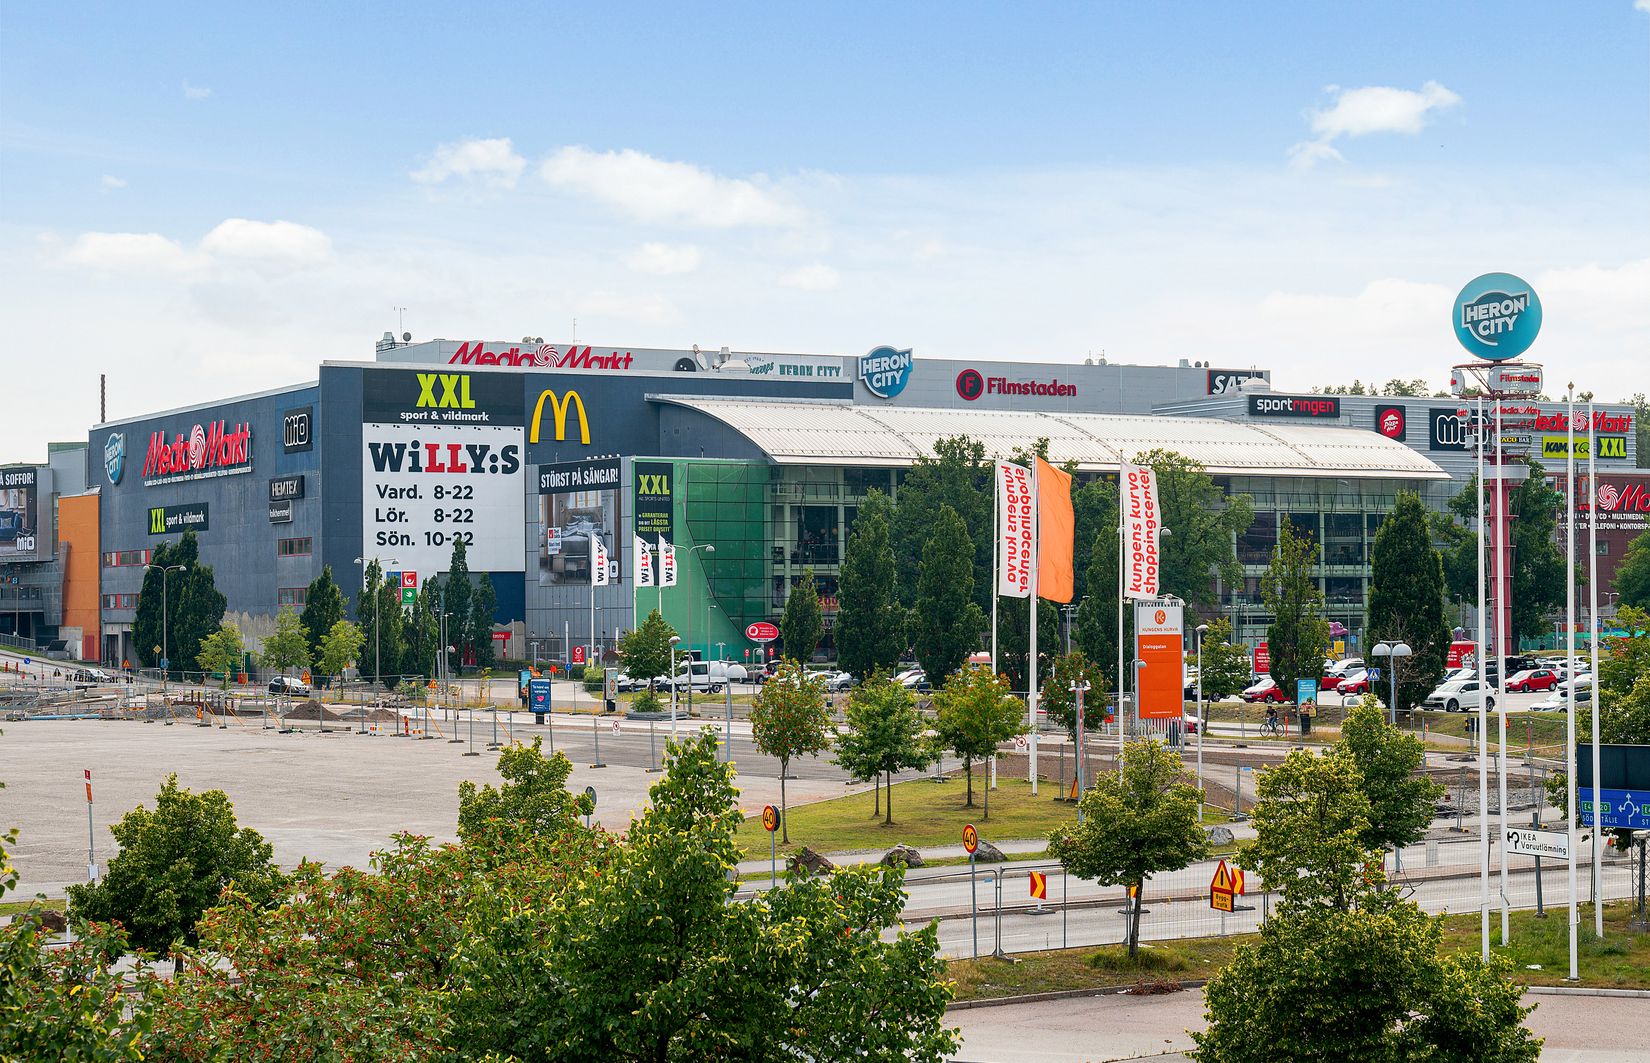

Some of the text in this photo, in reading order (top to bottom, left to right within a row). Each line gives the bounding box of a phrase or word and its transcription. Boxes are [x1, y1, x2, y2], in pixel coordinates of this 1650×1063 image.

[1466, 297, 1525, 322] HERON
[1478, 314, 1518, 336] CITY
[862, 353, 910, 374] HERON
[872, 369, 904, 388] CITY
[987, 377, 1077, 397] Filmstaden
[1212, 375, 1249, 394] SAT
[416, 373, 476, 409] XXL
[400, 411, 489, 421] sport & vildmark
[1257, 397, 1335, 416] sportringen
[142, 419, 251, 478] Media Markt
[1599, 438, 1627, 457] XXL
[5, 472, 34, 486] SOFFOR!
[541, 466, 619, 488] STÖRST PÅ SÄNGAR!
[638, 475, 670, 495] XXL
[375, 484, 474, 500] Vard. 8-22
[151, 508, 166, 533] XXL
[166, 515, 178, 528] sport
[183, 511, 205, 524] vildmark
[375, 507, 474, 523] Lör. 8-22
[376, 530, 416, 546] Sön.
[1139, 467, 1158, 595] shoppingcenter
[1129, 522, 1144, 593] kungens
[765, 811, 774, 825] 40
[1582, 813, 1618, 824] SÖDTÄLJE
[965, 831, 975, 846] 40
[1520, 832, 1537, 842] IKEA
[1520, 841, 1567, 856] Varuutlämning
